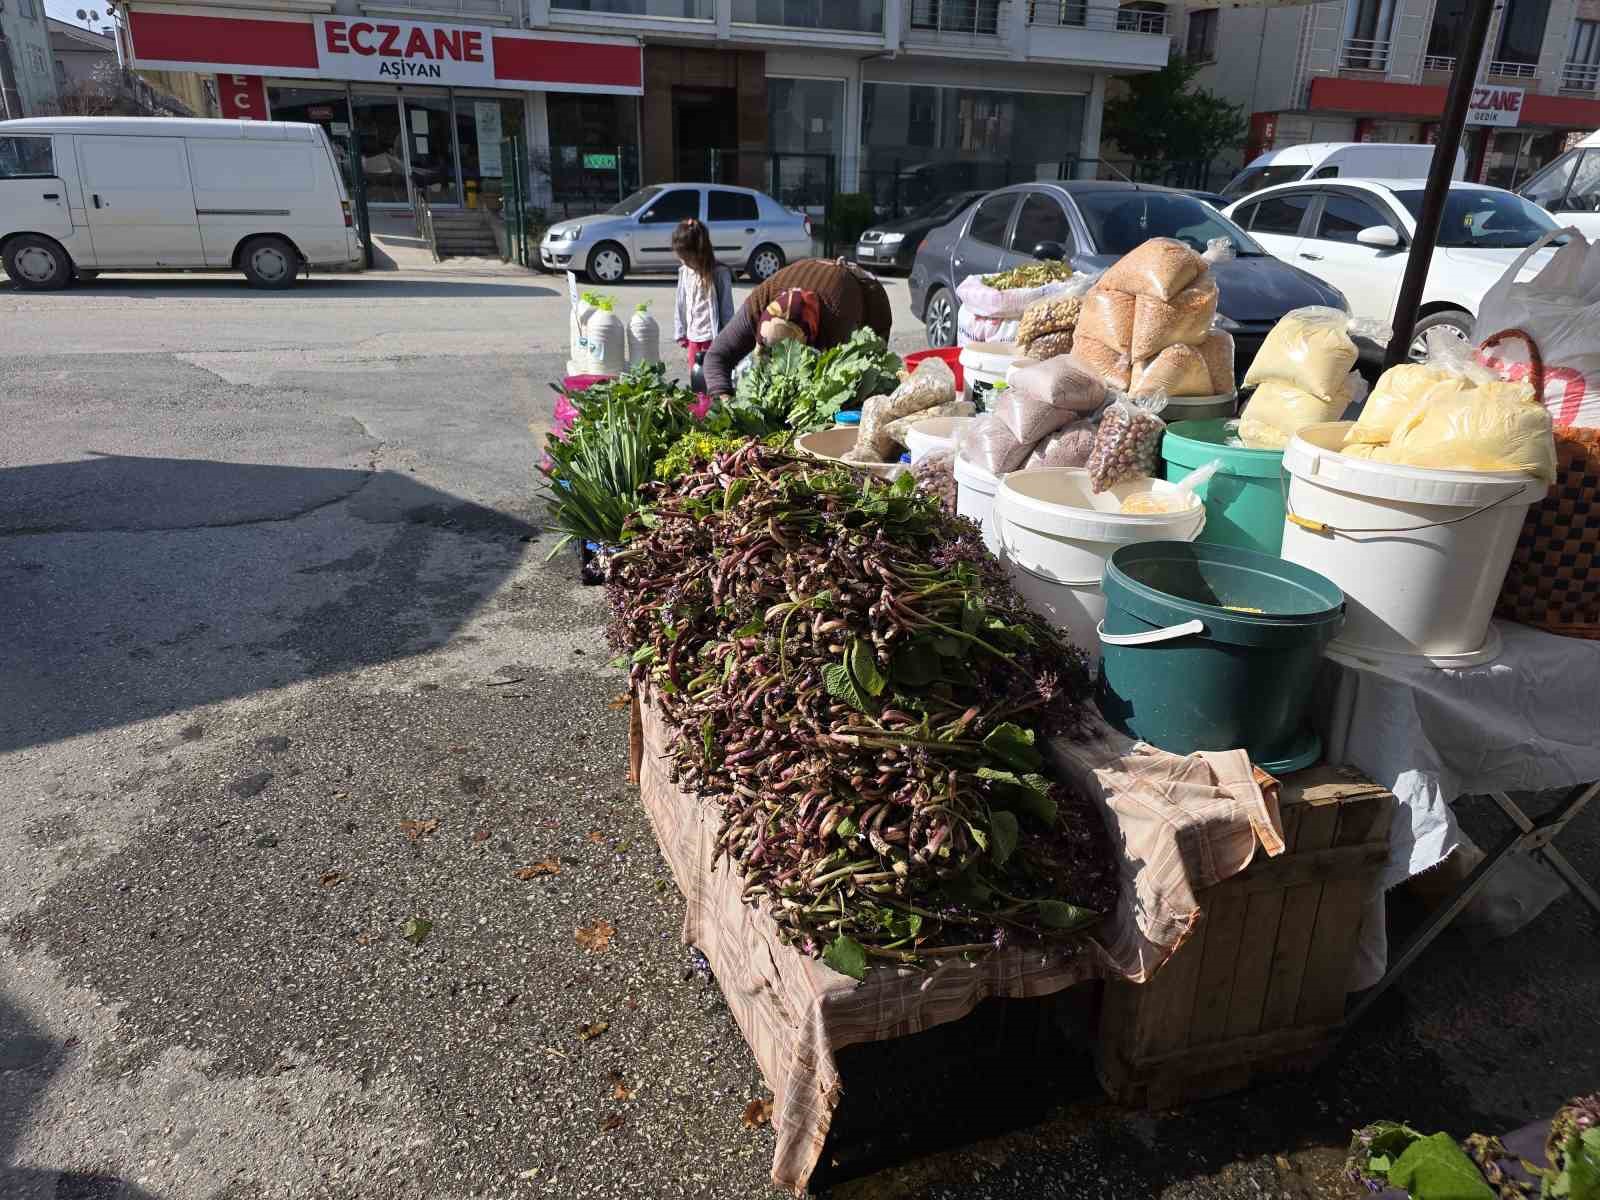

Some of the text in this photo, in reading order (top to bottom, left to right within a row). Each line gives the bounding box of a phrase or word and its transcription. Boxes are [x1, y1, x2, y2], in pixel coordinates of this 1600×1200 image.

[324, 20, 484, 63] ECZANE
[379, 58, 441, 79] AŞİYAN
[232, 75, 252, 119] EC
[1470, 89, 1521, 111] CZANE
